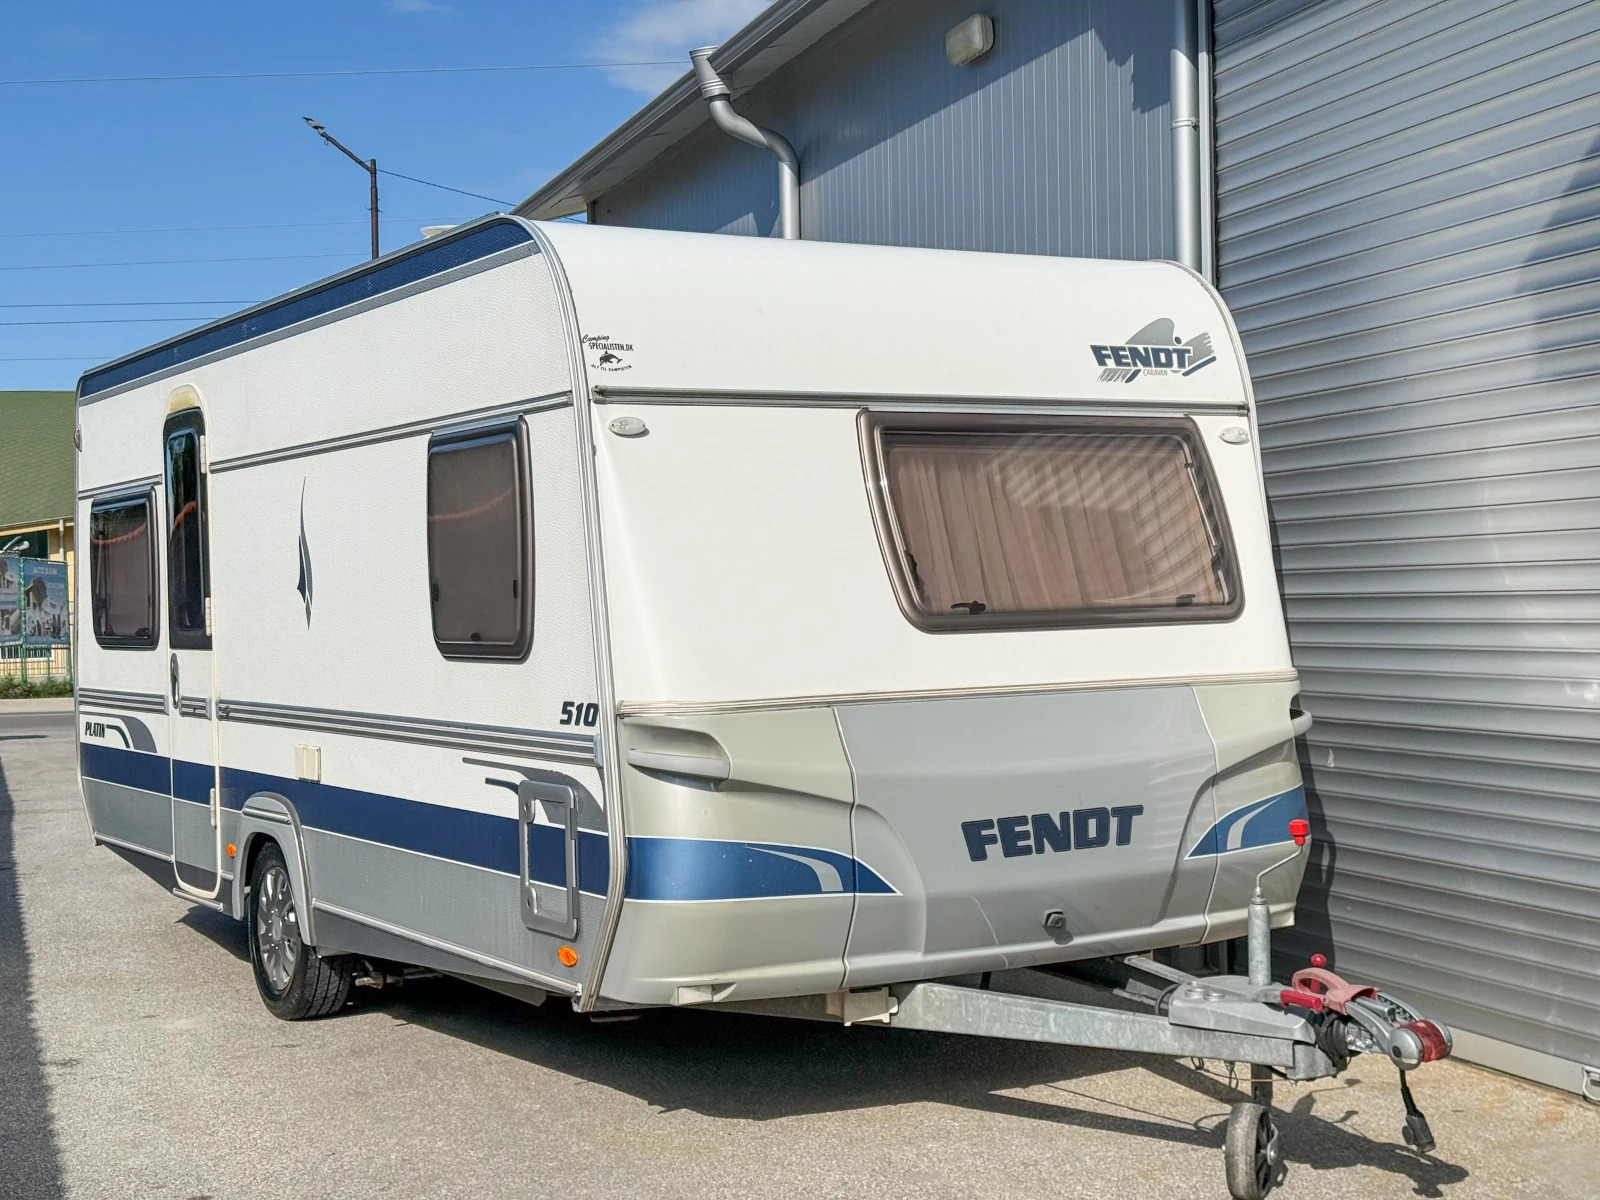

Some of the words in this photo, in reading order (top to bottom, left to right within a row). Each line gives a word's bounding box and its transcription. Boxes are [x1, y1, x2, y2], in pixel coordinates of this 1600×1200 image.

[1089, 344, 1192, 369] FENDT
[1142, 368, 1169, 377] CARAVAN
[559, 700, 600, 728] 510
[84, 721, 106, 739] PLATIN
[960, 804, 1145, 863] FENDT
